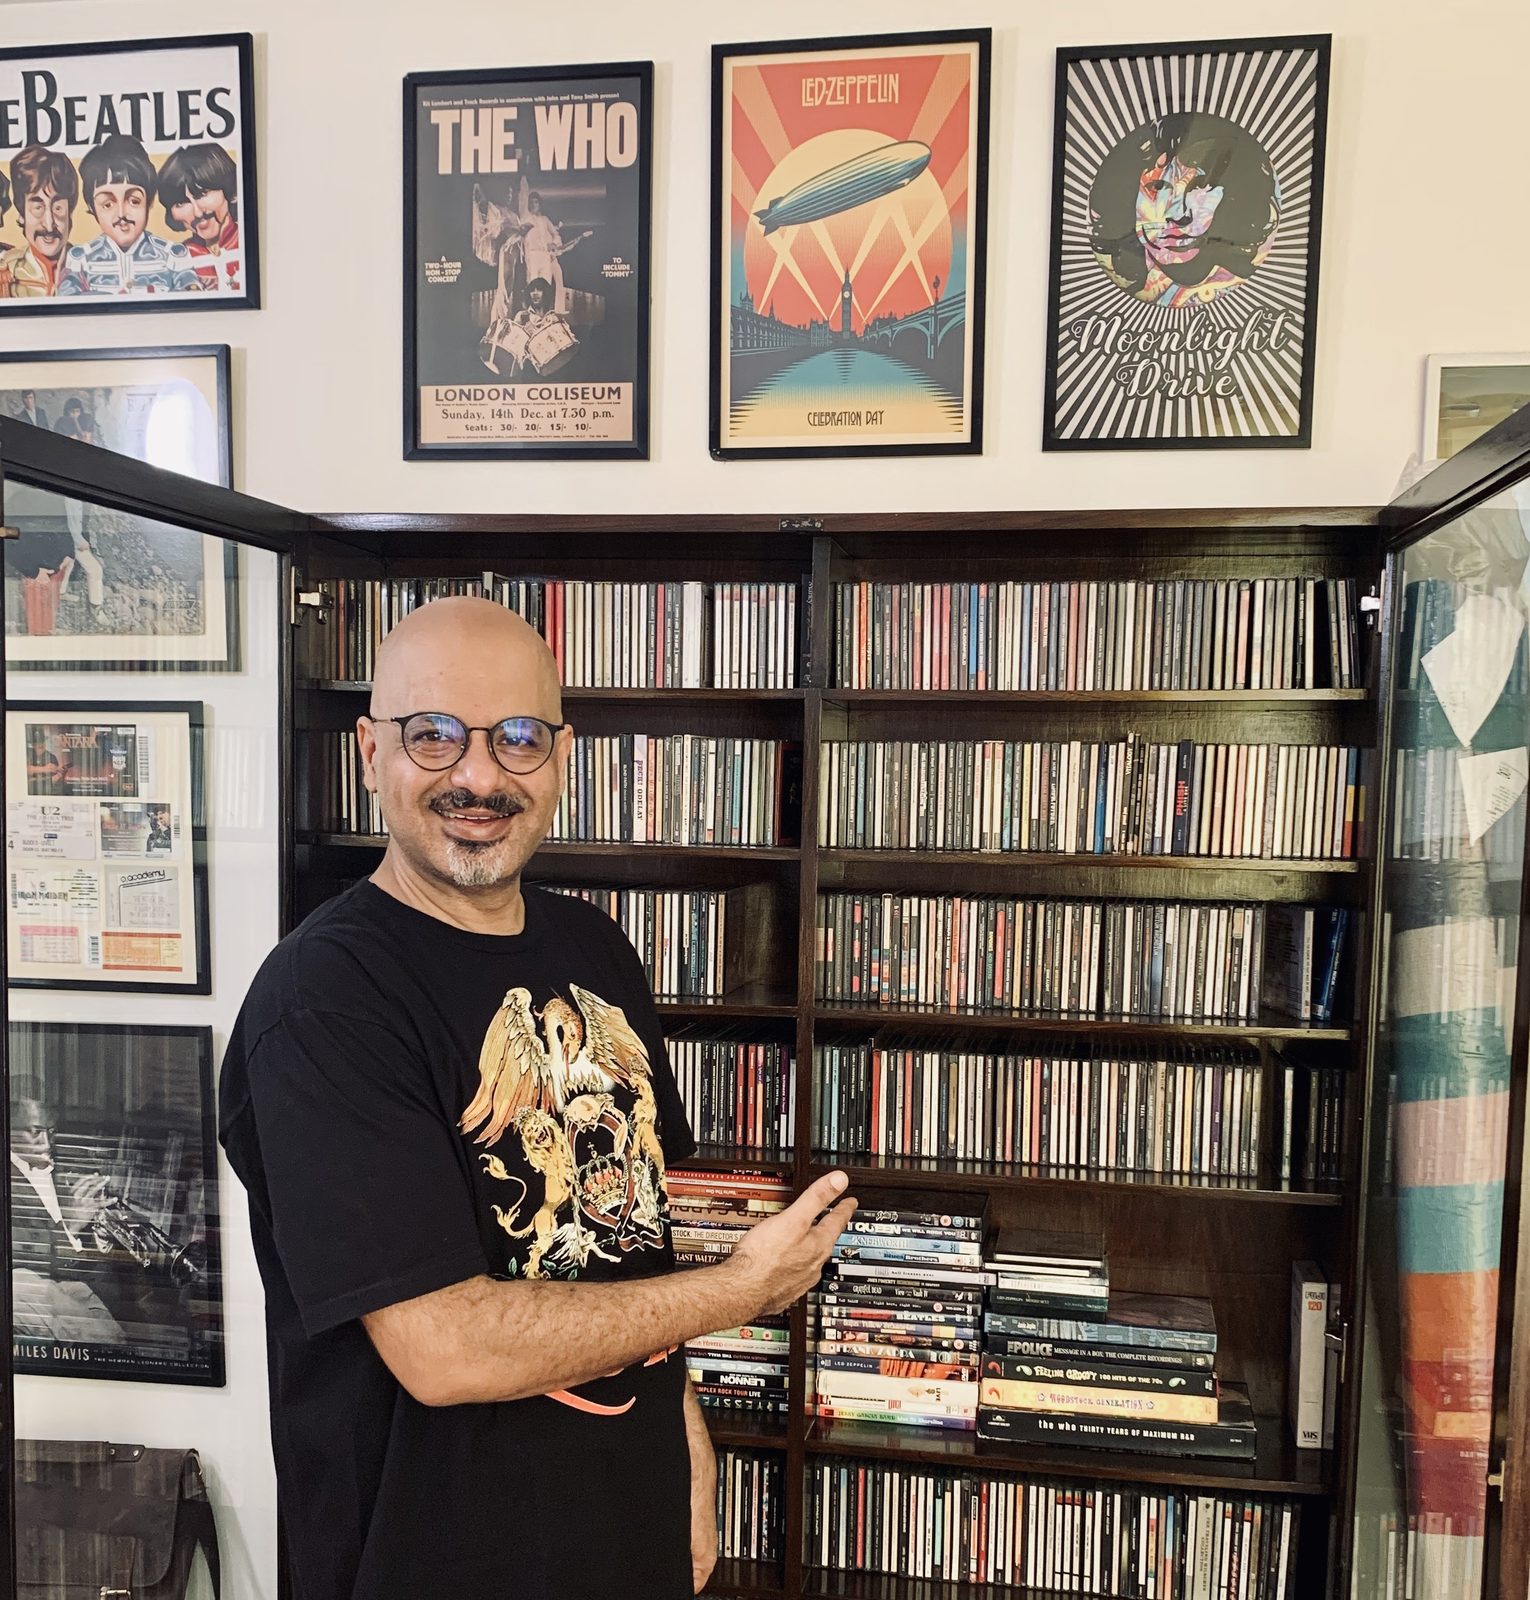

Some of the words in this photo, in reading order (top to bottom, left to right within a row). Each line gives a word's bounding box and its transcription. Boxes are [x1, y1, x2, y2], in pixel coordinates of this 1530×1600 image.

[21, 70, 235, 147] BEATLES
[430, 107, 518, 175] THE
[534, 102, 638, 171] WHO
[1071, 308, 1293, 370] Moonlight
[1116, 358, 1236, 398] Drive
[435, 387, 516, 402] LONDON
[526, 386, 621, 401] COLISEUM
[490, 408, 514, 419] 14th
[520, 408, 544, 419] Dec.
[547, 409, 557, 419] at
[561, 407, 587, 419] 7.30
[592, 410, 615, 421] p.m.
[807, 411, 862, 427] CELEBRATION
[865, 410, 884, 426] DAY
[1125, 747, 1133, 776] VITALOGY
[1176, 780, 1185, 816] PHISH
[127, 869, 166, 882] academy
[17, 891, 37, 900] IRON
[38, 891, 68, 901] MAIDEN
[672, 1227, 693, 1238] STOCK:
[694, 1230, 705, 1238] THE
[705, 1230, 739, 1240] DIRECTOR'S
[855, 1221, 901, 1235] QUEEN
[703, 1242, 721, 1253] SOUND
[721, 1244, 732, 1254] CITY
[675, 1253, 693, 1261] LAST
[695, 1254, 717, 1263] WALTZ
[883, 1252, 904, 1260] Blues
[905, 1254, 939, 1263] Brothers
[871, 1285, 882, 1295] DEAD
[894, 1288, 905, 1296] View
[1304, 1290, 1326, 1300] FUJI
[1307, 1301, 1323, 1311] 120
[896, 1311, 945, 1322] BEATLES
[53, 1346, 90, 1361] DAVIS
[875, 1346, 916, 1359] ZAPPA
[1014, 1341, 1053, 1357] POLICE
[1054, 1347, 1079, 1356] MESSAGE
[1105, 1351, 1117, 1359] THE
[1117, 1352, 1147, 1361] COMPLETE
[1147, 1354, 1183, 1364] RECORDINGS
[719, 1374, 766, 1387] LENNON
[1034, 1365, 1064, 1378] FEELING
[1066, 1369, 1098, 1382] GROOVY
[1099, 1373, 1111, 1381] 100
[1112, 1374, 1127, 1382] HITS
[1137, 1376, 1151, 1384] THE
[717, 1387, 733, 1395] ROCK
[748, 1390, 761, 1398] LIVE
[1050, 1393, 1094, 1405] WOODSTOCK
[1096, 1396, 1145, 1409] GENERATION
[1038, 1418, 1054, 1431] the
[1058, 1420, 1077, 1432] who
[1079, 1424, 1105, 1434] THIRTY
[1107, 1426, 1130, 1436] YEARS
[1131, 1428, 1141, 1437] OF
[1143, 1429, 1178, 1440] MAXIMUM
[1302, 1430, 1318, 1440] VHS
